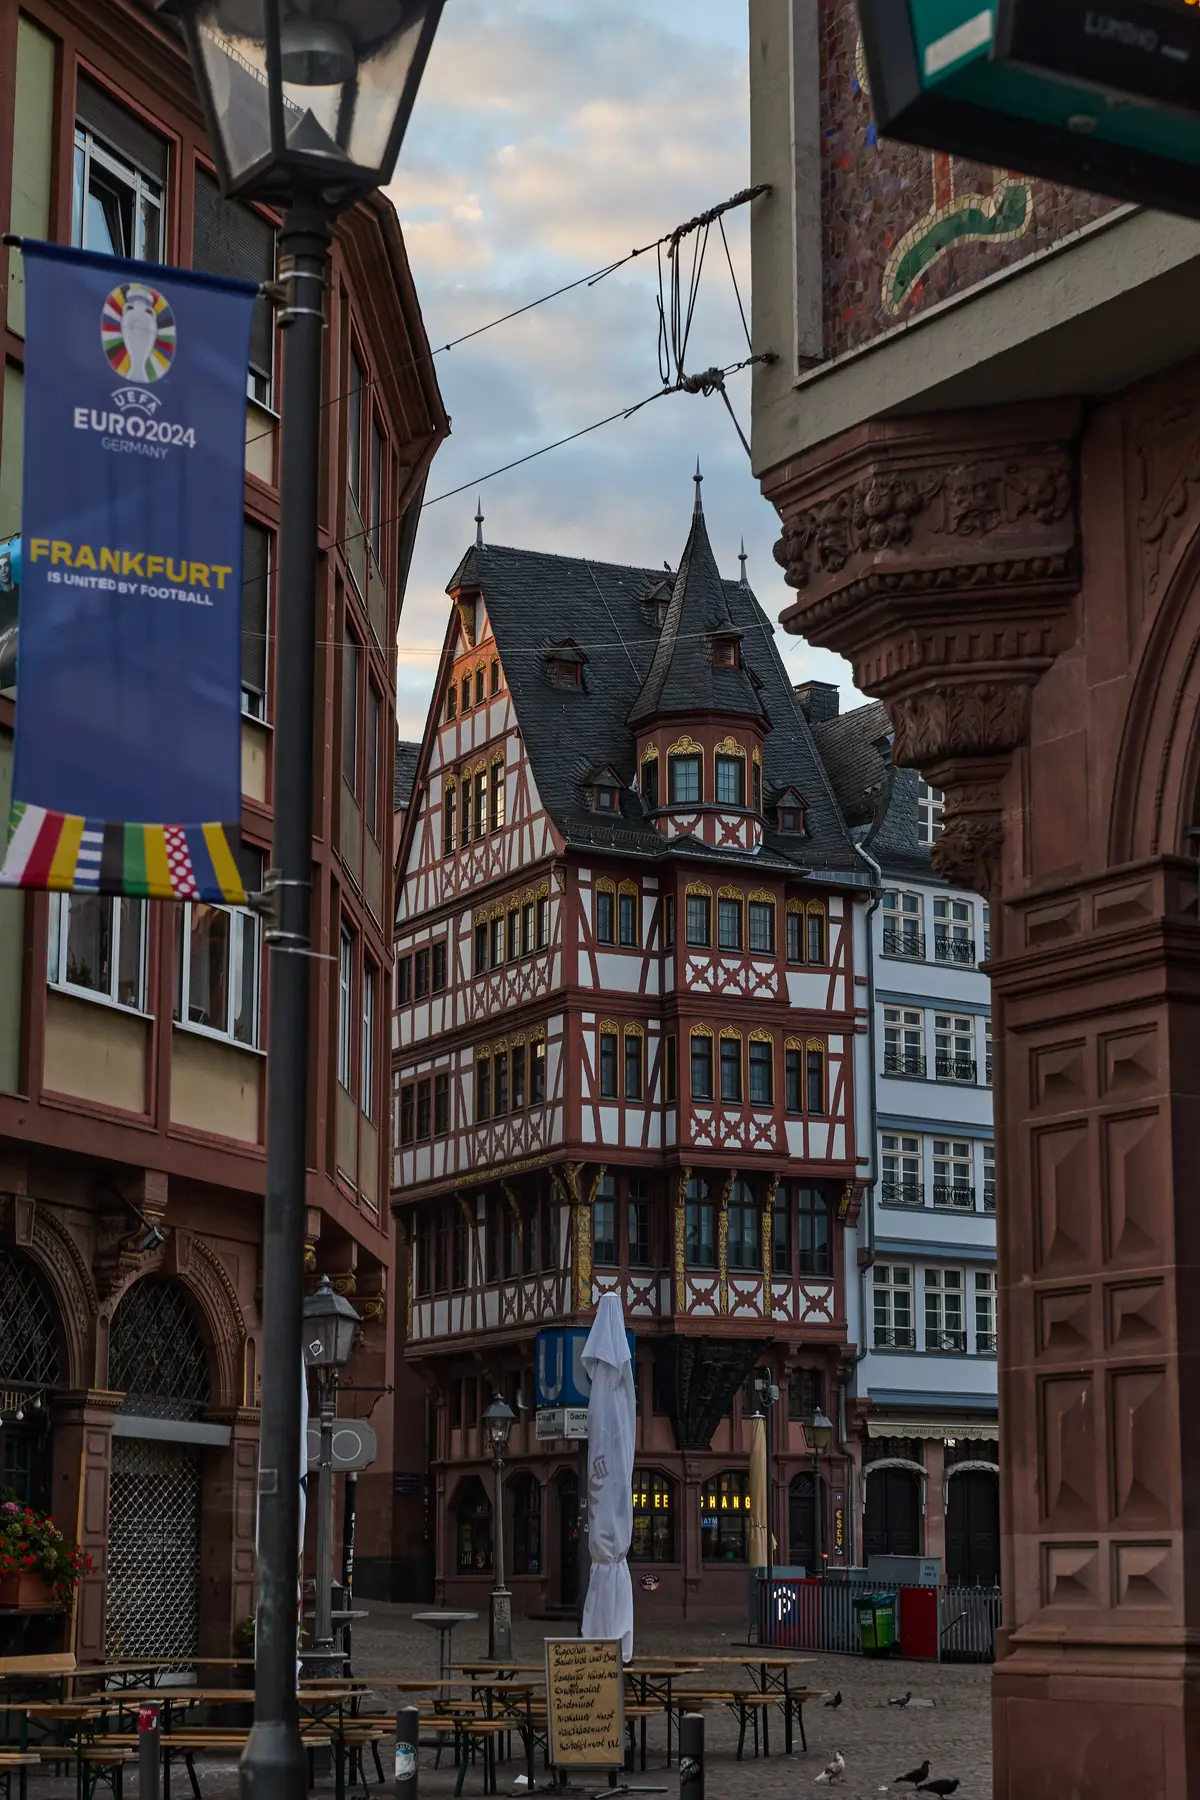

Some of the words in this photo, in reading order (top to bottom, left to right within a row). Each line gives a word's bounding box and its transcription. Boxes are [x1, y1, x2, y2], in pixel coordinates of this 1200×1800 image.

[114, 391, 157, 414] UEFA
[101, 437, 168, 460] GERMANY
[30, 538, 232, 590] FRANKFURT
[47, 571, 61, 583] IS
[64, 572, 116, 590] UNITED
[118, 581, 139, 595] BY
[140, 585, 214, 606] FOOTBALL
[540, 1336, 563, 1400] U
[570, 1412, 589, 1420] Sach
[633, 1494, 668, 1508] FFEE
